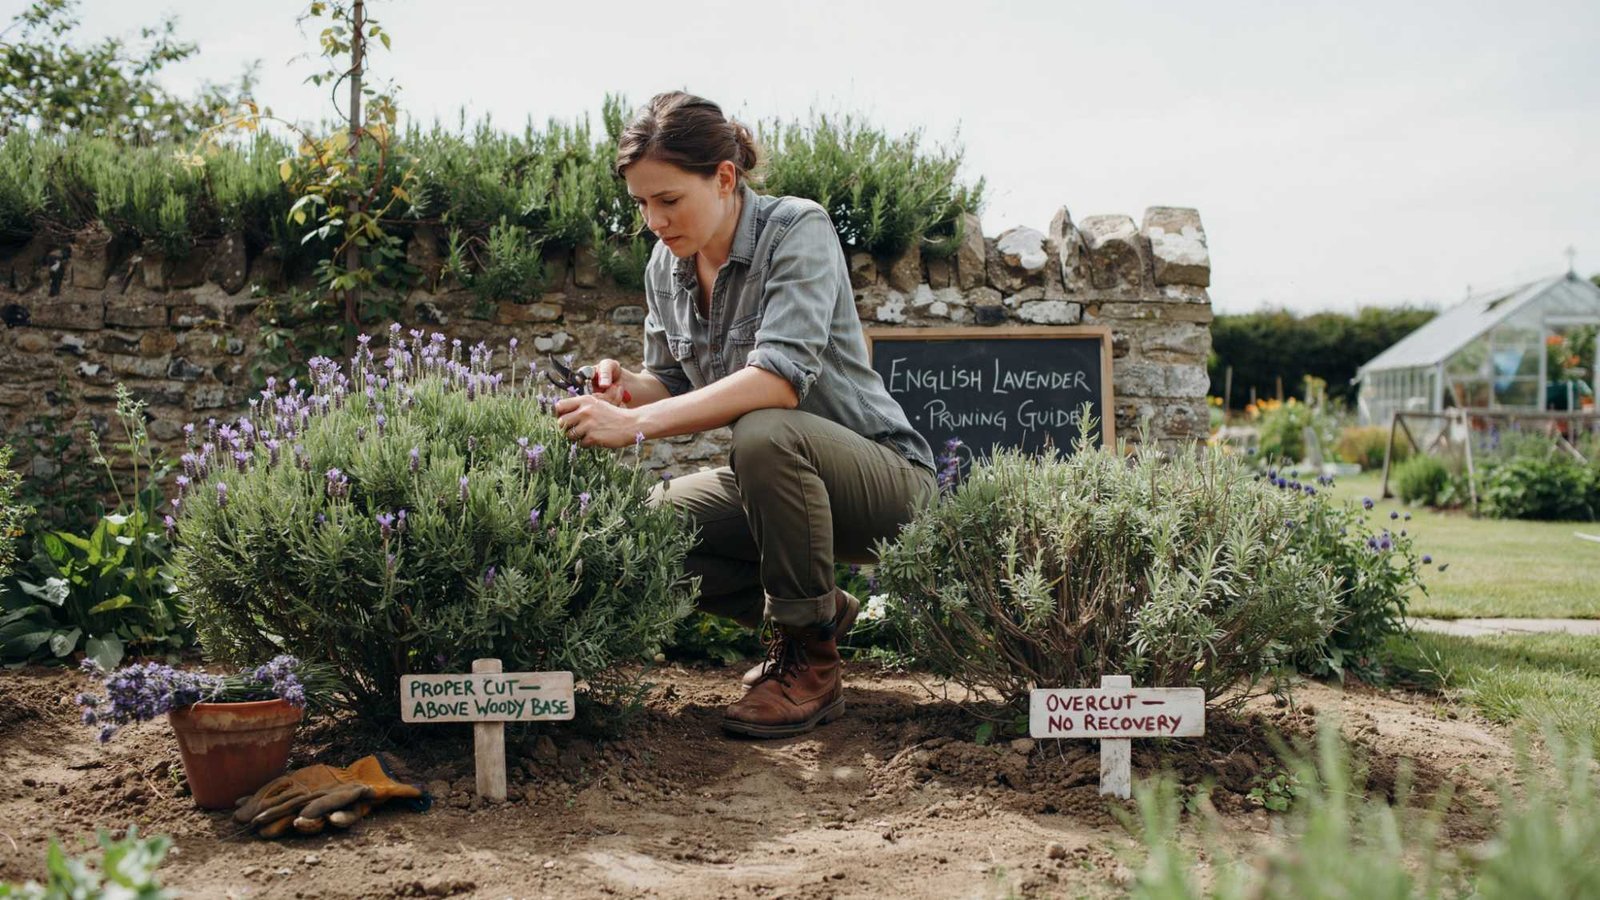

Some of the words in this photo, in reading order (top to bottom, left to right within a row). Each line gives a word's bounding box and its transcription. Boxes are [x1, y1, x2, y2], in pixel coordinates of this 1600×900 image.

[993, 358, 1092, 394] LAVENDER
[410, 680, 476, 698] PROPER
[413, 701, 469, 719] ABOVE
[474, 699, 526, 719] WOODY
[531, 698, 570, 716] BASE
[1046, 693, 1138, 712] OVERCUT
[1048, 715, 1074, 733] NO
[1084, 713, 1182, 734] RECOVERY
